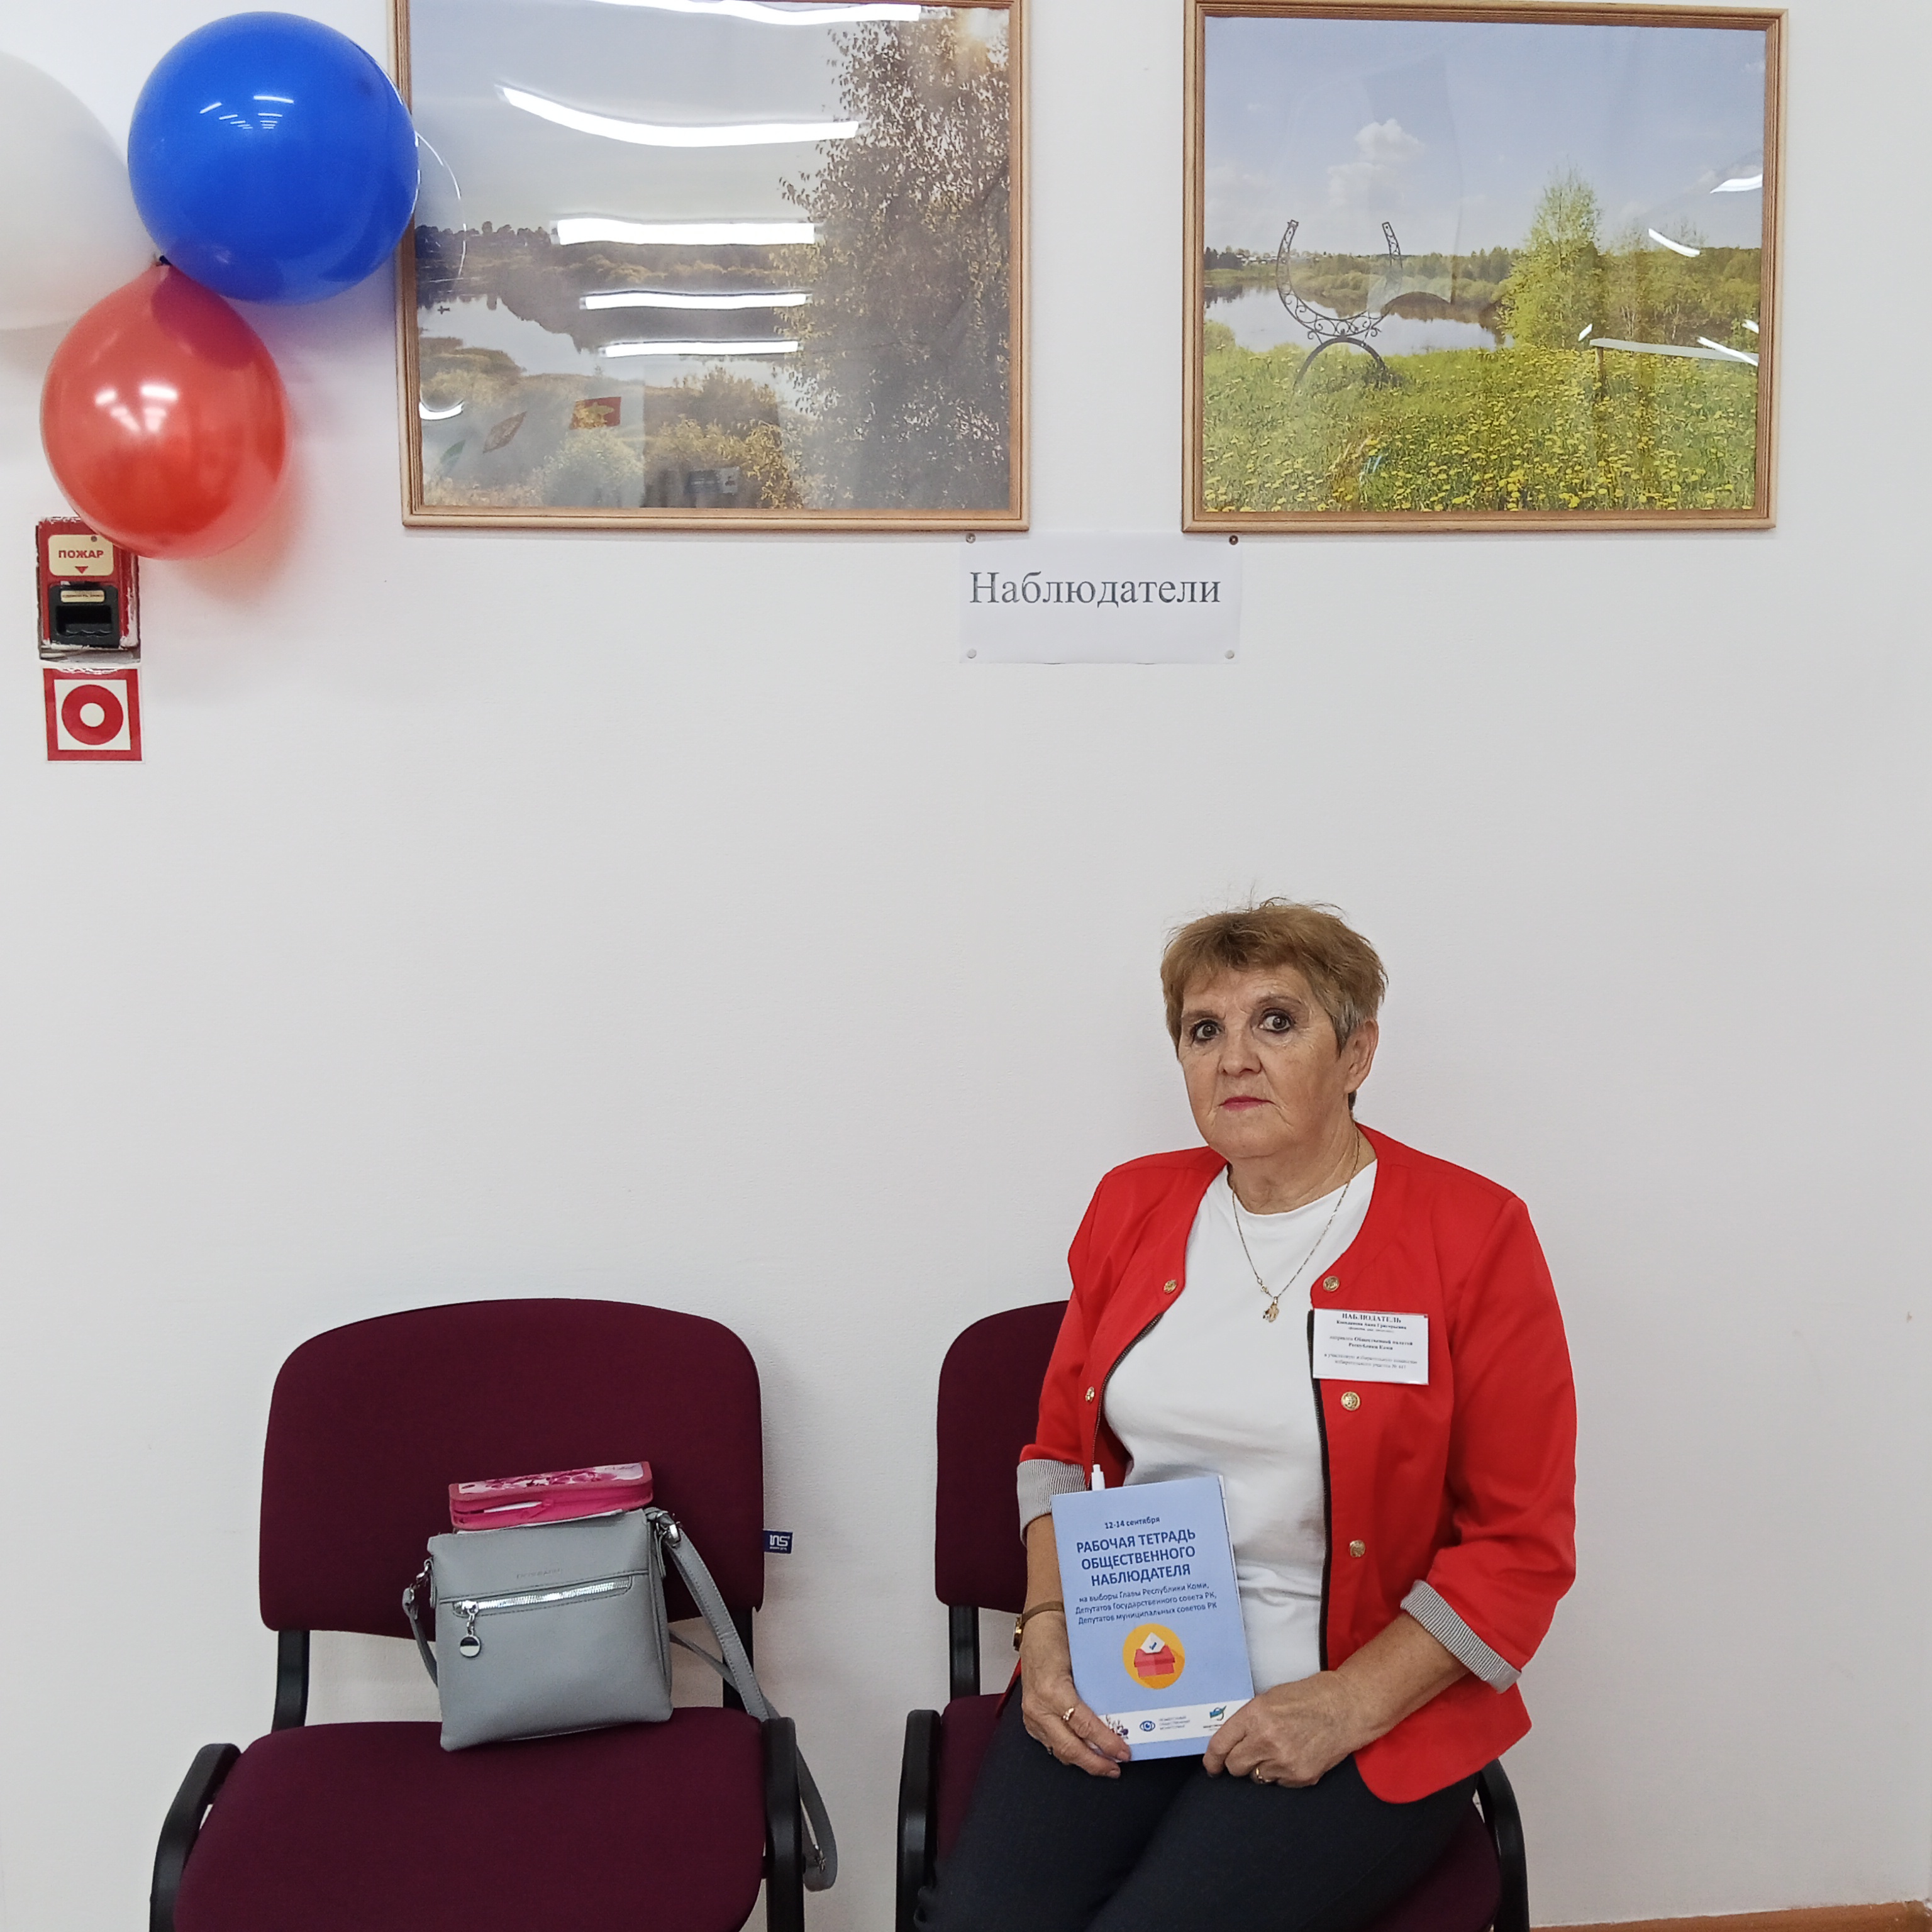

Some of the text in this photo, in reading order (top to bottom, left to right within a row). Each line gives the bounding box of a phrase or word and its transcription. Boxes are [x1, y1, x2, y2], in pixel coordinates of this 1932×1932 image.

[58, 550, 104, 558] ПОЖАР
[969, 570, 1221, 608] Наблюдатели
[1342, 1313, 1401, 1323] НАБЛЮДАТЕЛЬ
[1104, 1516, 1160, 1530] 12-14 сентября
[1077, 1529, 1196, 1553] РАБОЧАЯ ТЕТРАДЬ
[1081, 1545, 1196, 1570] ОБЩЕСТВЕННОГО
[1091, 1563, 1191, 1587] НАБЛЮДАТЕЛЯ
[1075, 1591, 1217, 1615] Депутатов Государственного совета РК,
[1089, 1593, 1118, 1602] выборы
[1119, 1590, 1141, 1599] Главы
[1142, 1585, 1185, 1596] Республики
[1187, 1582, 1209, 1591] Коми,
[1079, 1602, 1217, 1625] Депутатов муниципальных советов РК
